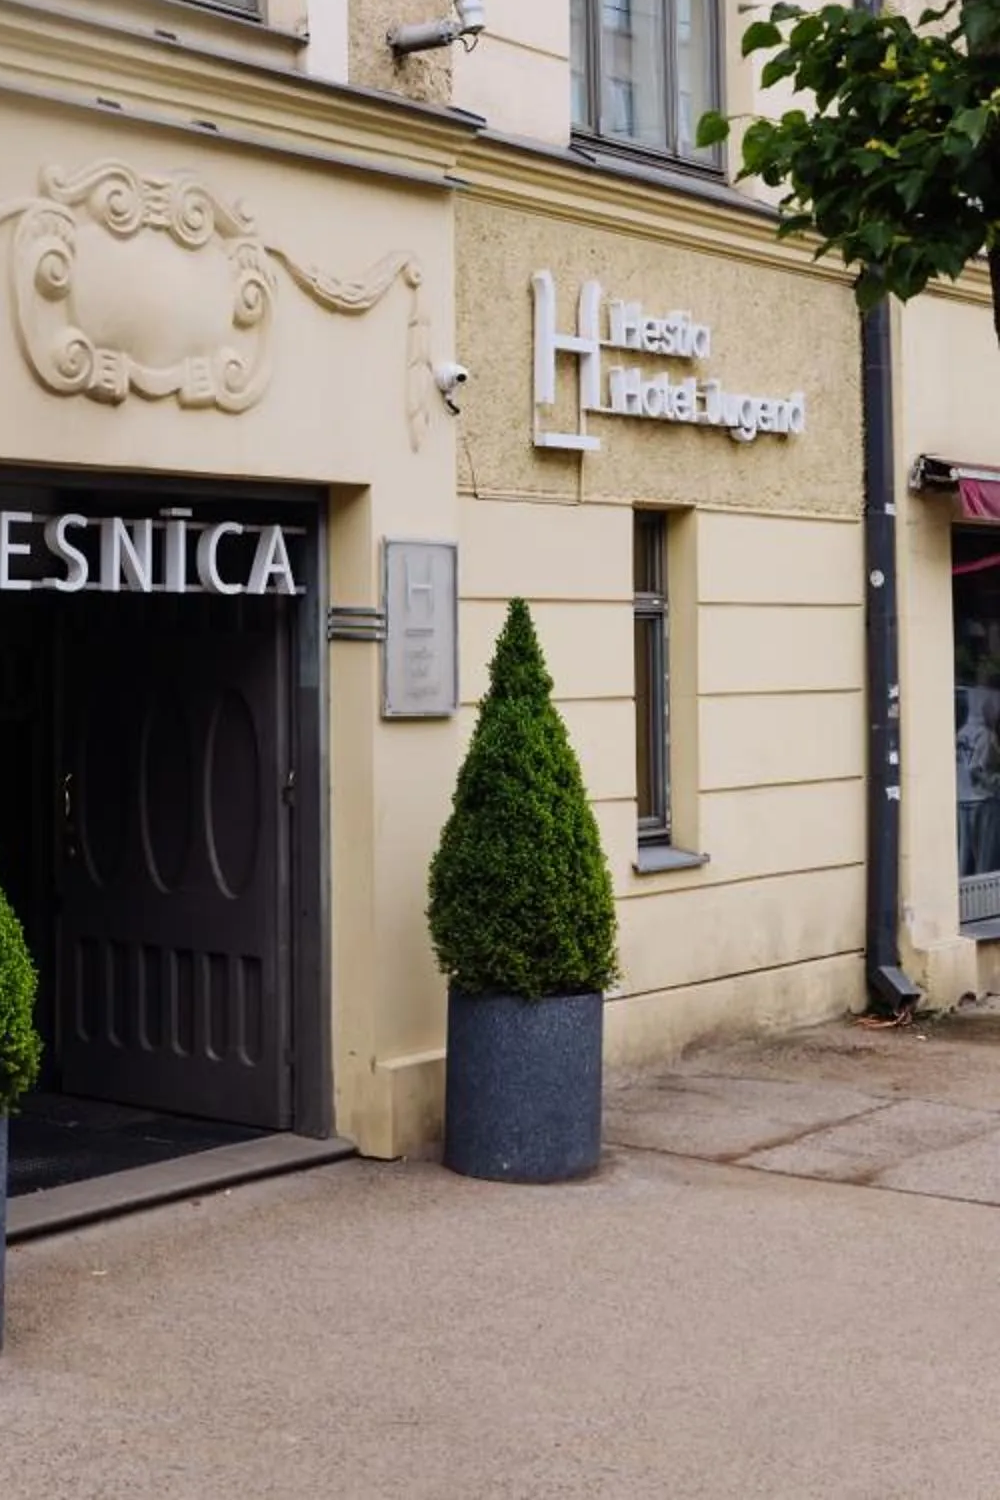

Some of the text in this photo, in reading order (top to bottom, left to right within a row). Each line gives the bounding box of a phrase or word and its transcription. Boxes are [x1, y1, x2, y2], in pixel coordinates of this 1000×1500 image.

[608, 299, 711, 358] Hestia
[609, 365, 805, 443] Hotel Jugend
